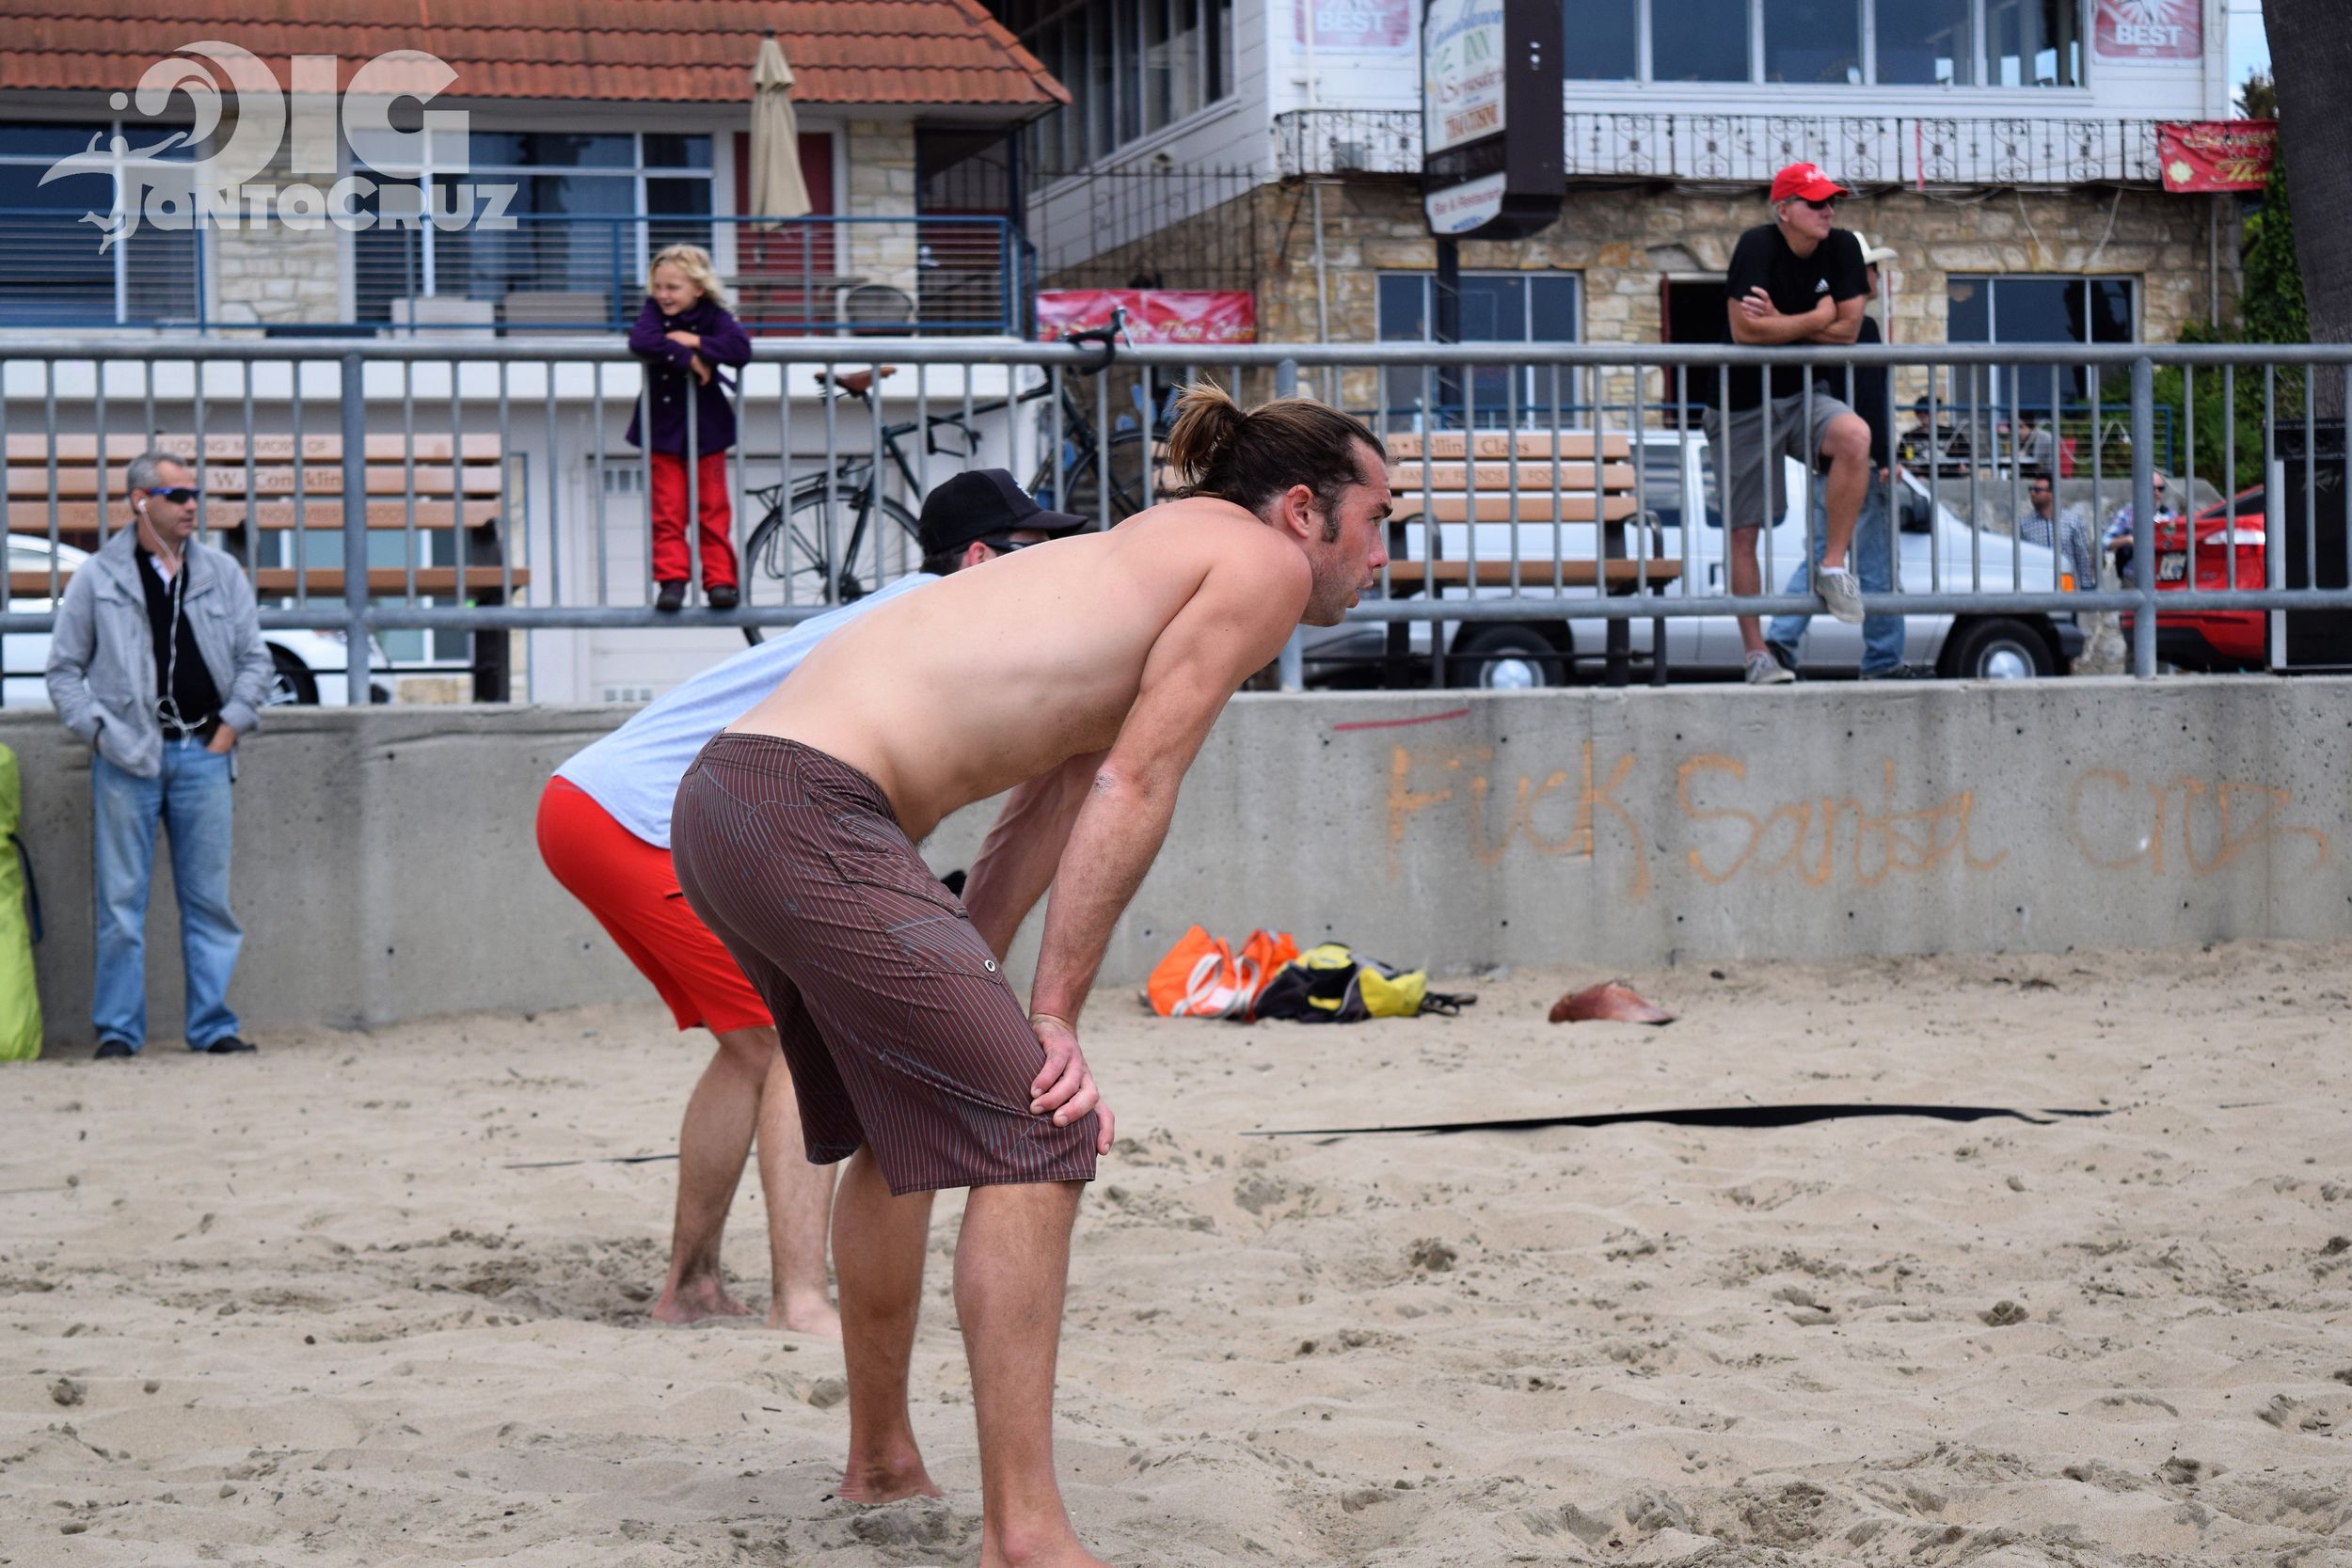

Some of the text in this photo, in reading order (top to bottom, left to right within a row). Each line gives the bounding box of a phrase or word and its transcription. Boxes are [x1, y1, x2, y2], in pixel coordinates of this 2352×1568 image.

[1316, 10, 1386, 33] BEST
[2115, 24, 2183, 47] BEST
[1677, 753, 2009, 889] Santa
